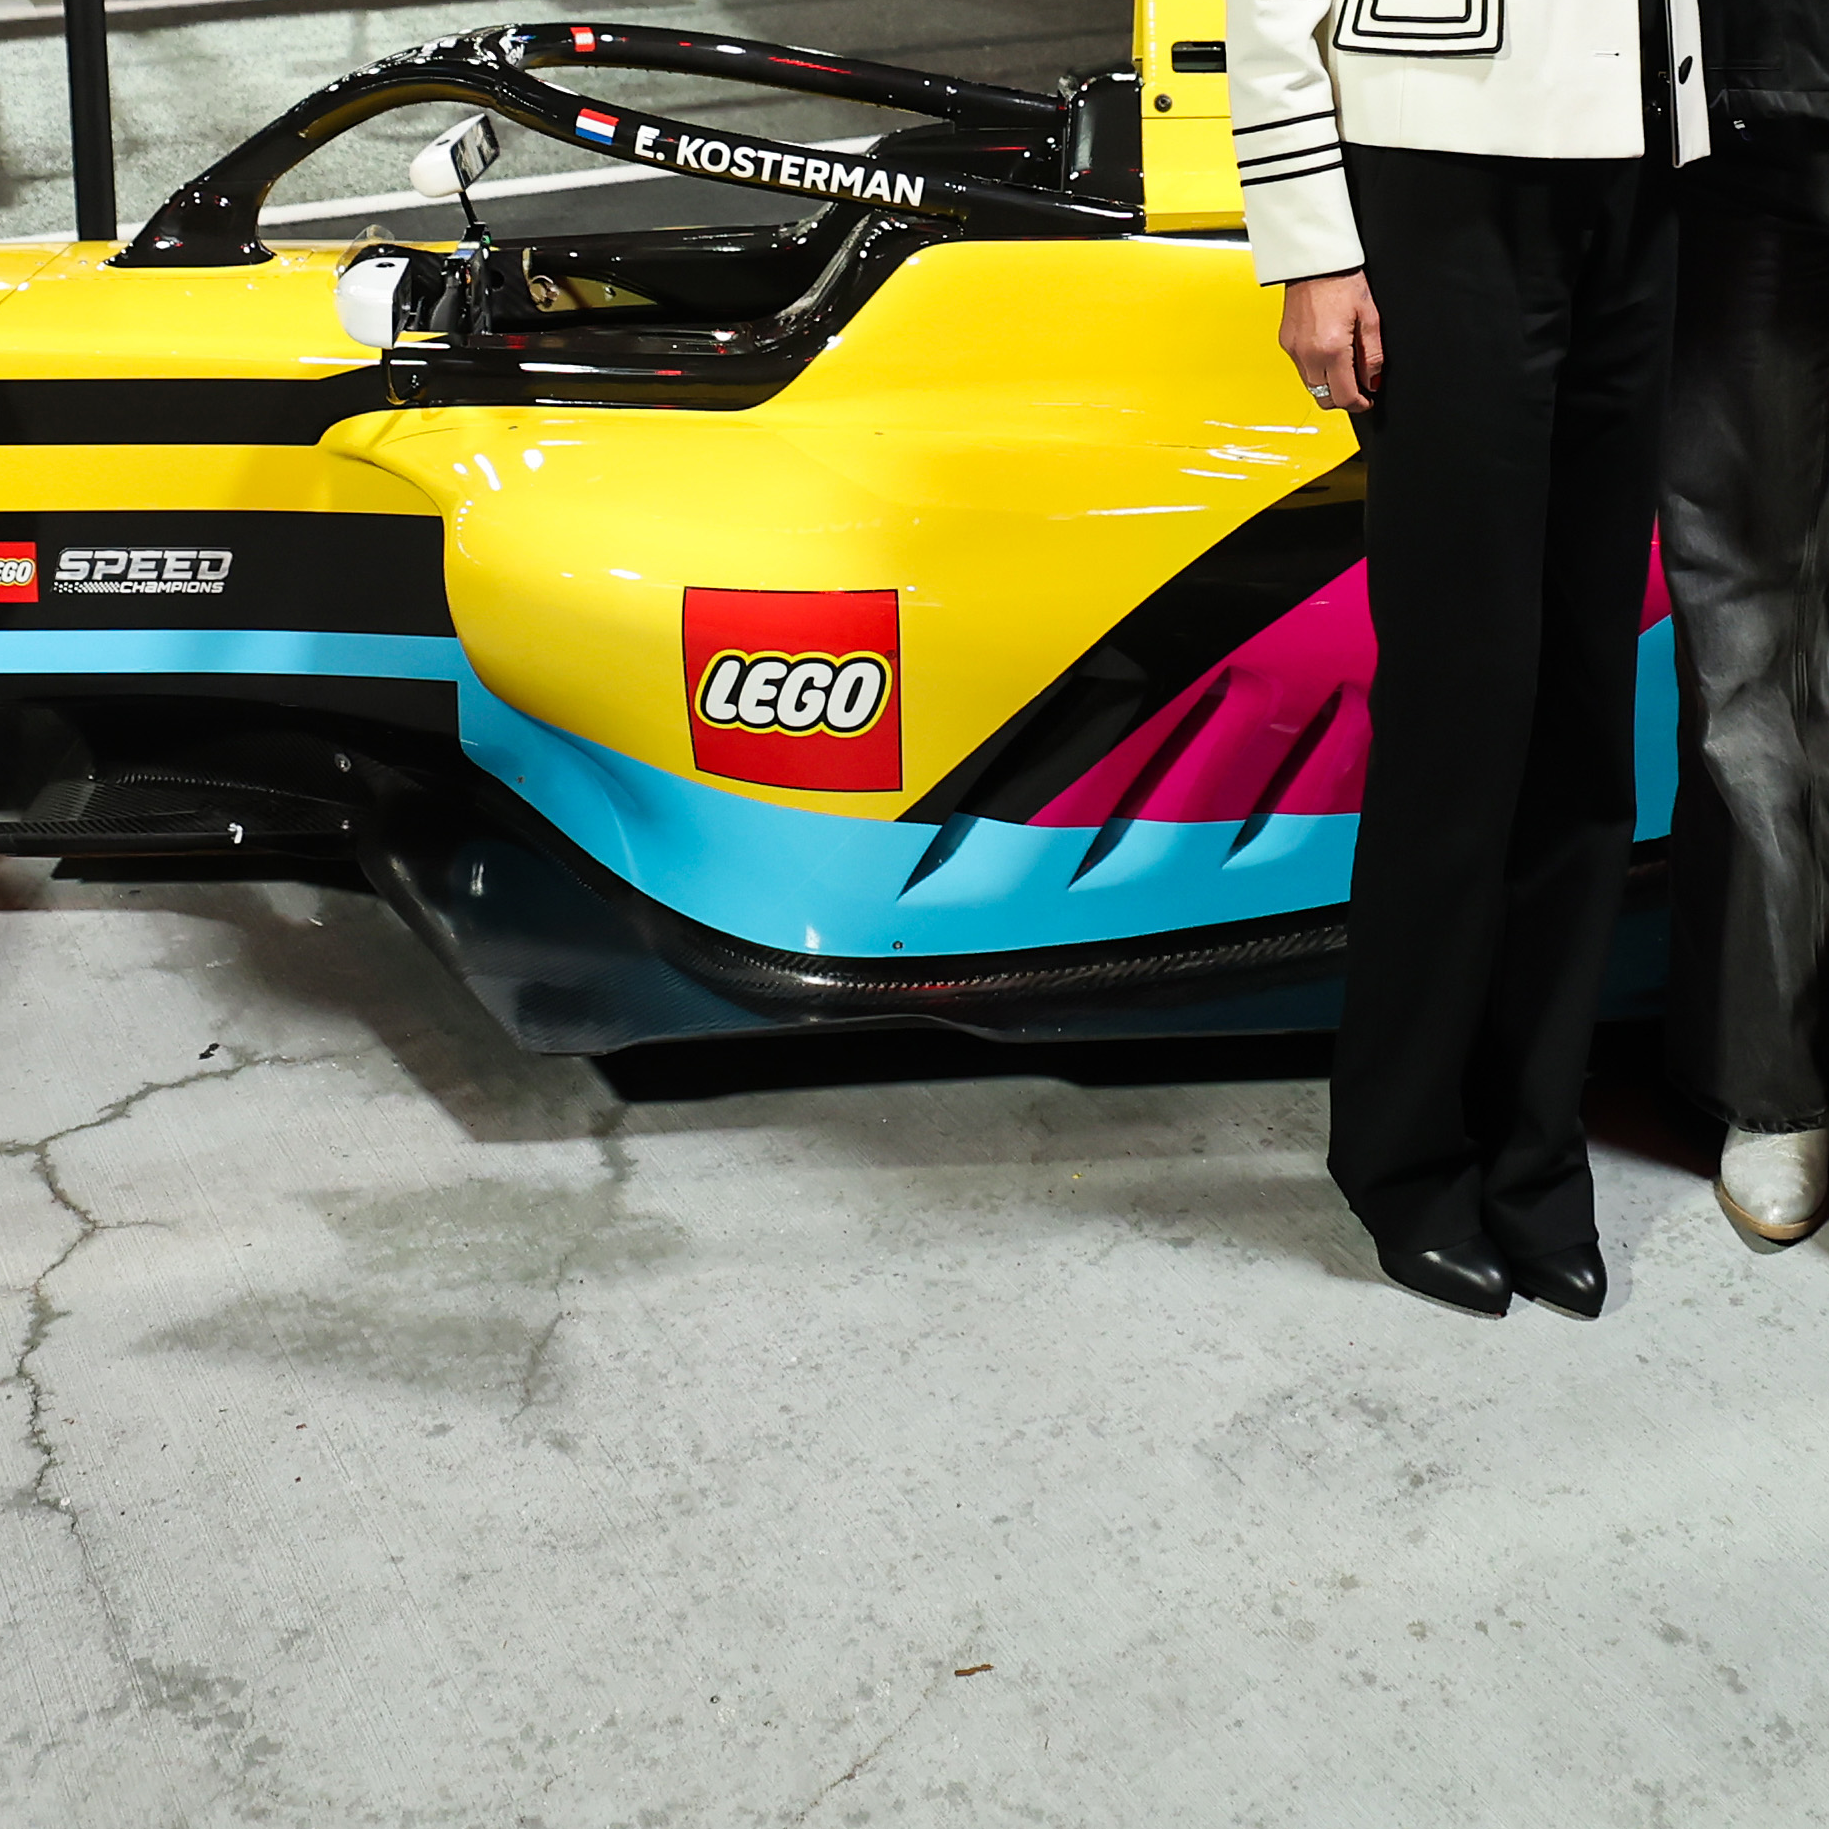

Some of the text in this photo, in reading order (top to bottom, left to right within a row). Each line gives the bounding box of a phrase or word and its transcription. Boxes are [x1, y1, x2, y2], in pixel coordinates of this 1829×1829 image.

[632, 125, 926, 208] E. KOSTERMAN
[54, 550, 234, 581] SPEED
[705, 659, 882, 729] LEGO
